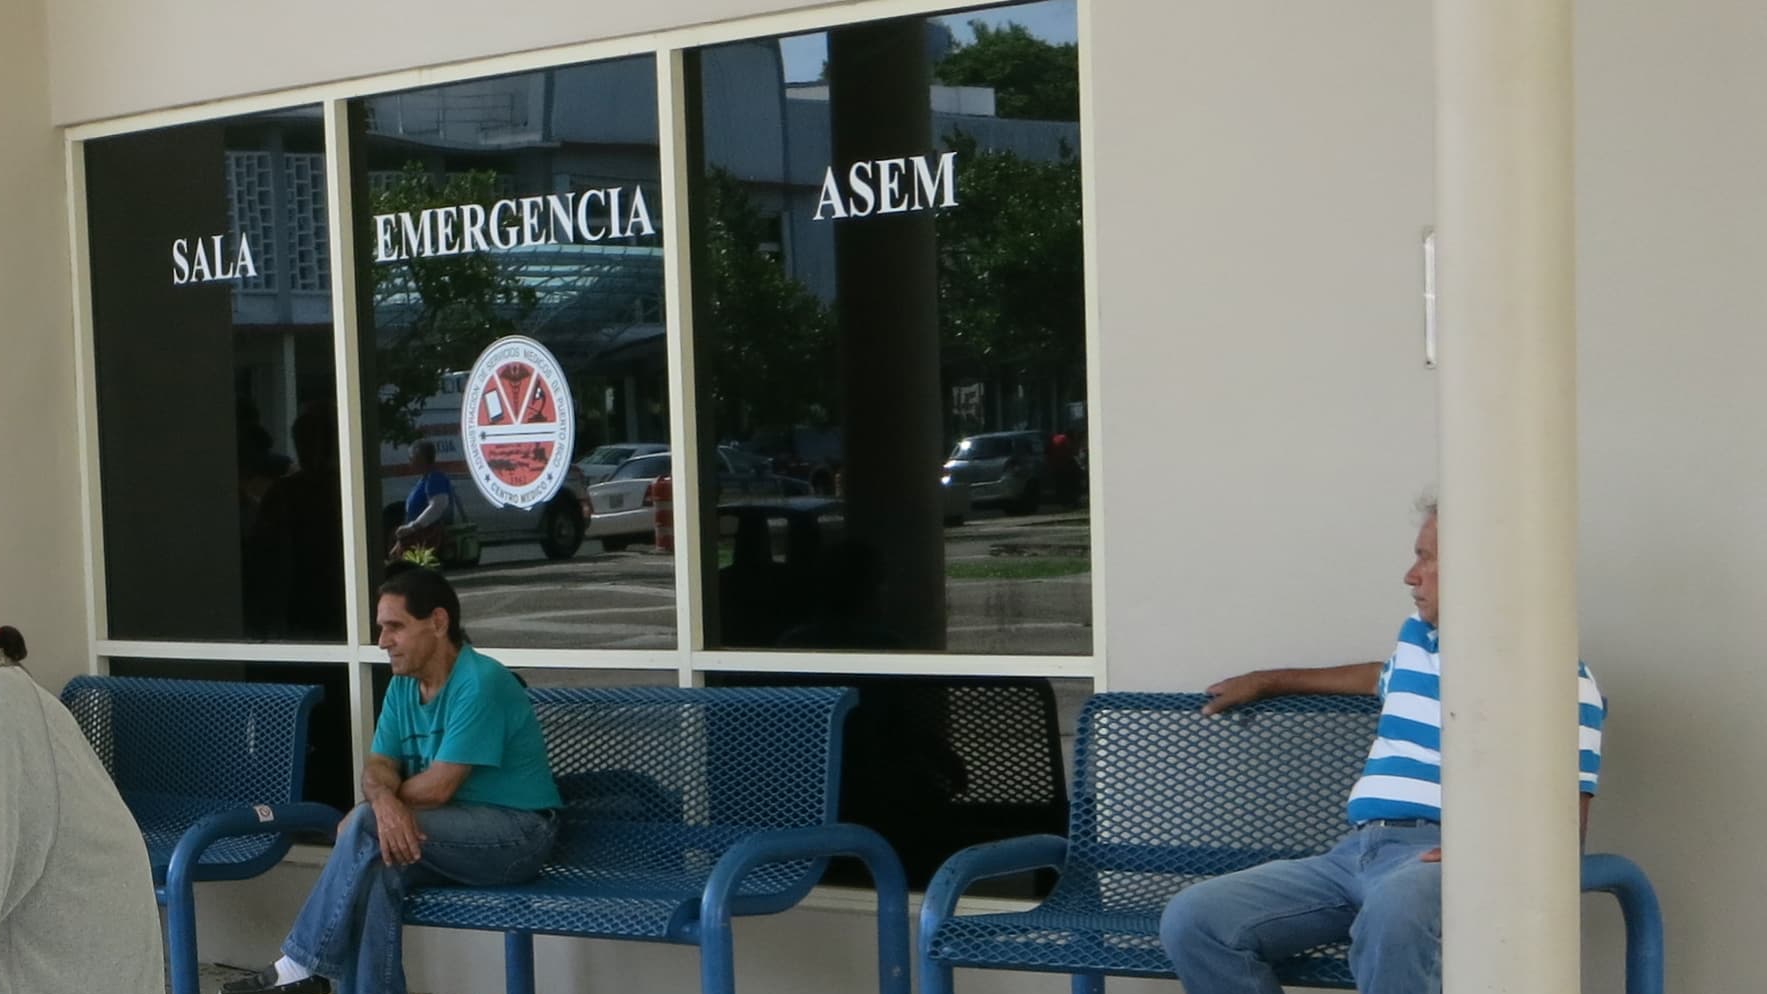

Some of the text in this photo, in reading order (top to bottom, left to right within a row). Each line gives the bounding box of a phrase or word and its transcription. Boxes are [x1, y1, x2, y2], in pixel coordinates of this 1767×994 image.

[172, 151, 960, 285] SALA EMERGENCIA ASEM
